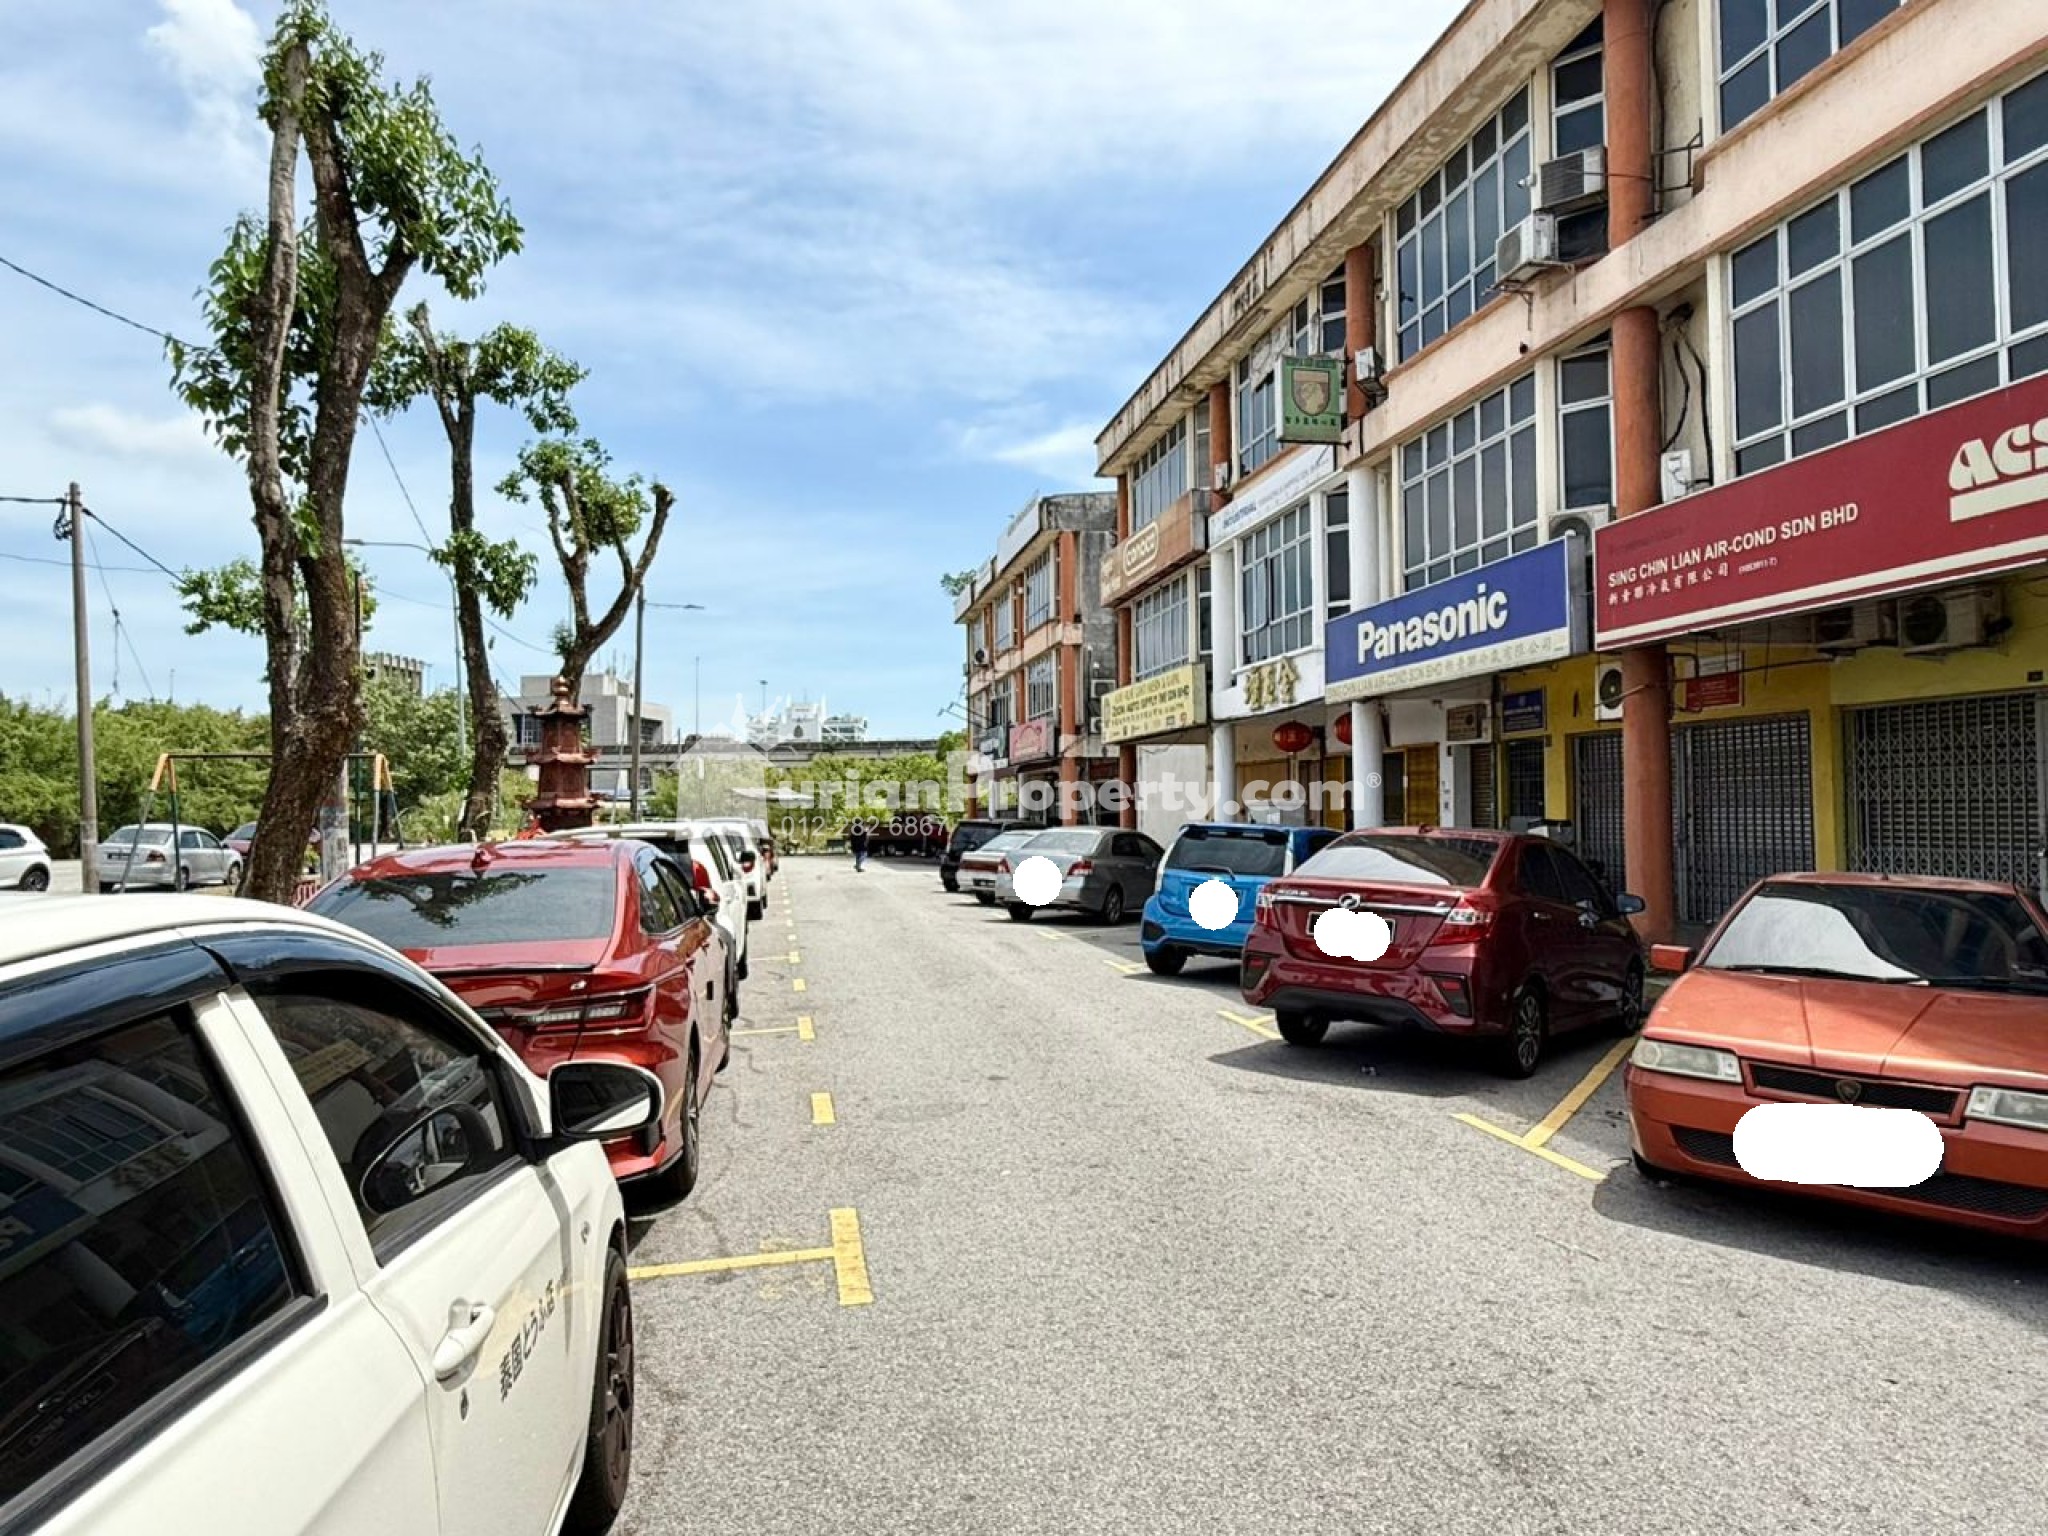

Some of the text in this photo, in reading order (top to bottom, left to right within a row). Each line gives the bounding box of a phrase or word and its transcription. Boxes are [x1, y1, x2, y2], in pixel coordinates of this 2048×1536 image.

[1607, 565, 1636, 588] SING
[1639, 557, 1669, 582] CHIN
[1671, 547, 1701, 575] LIAN
[1704, 525, 1777, 563] AIR-COND
[1780, 514, 1816, 541] SDN
[1819, 502, 1859, 530] BHD
[1357, 582, 1508, 665] Panasonic
